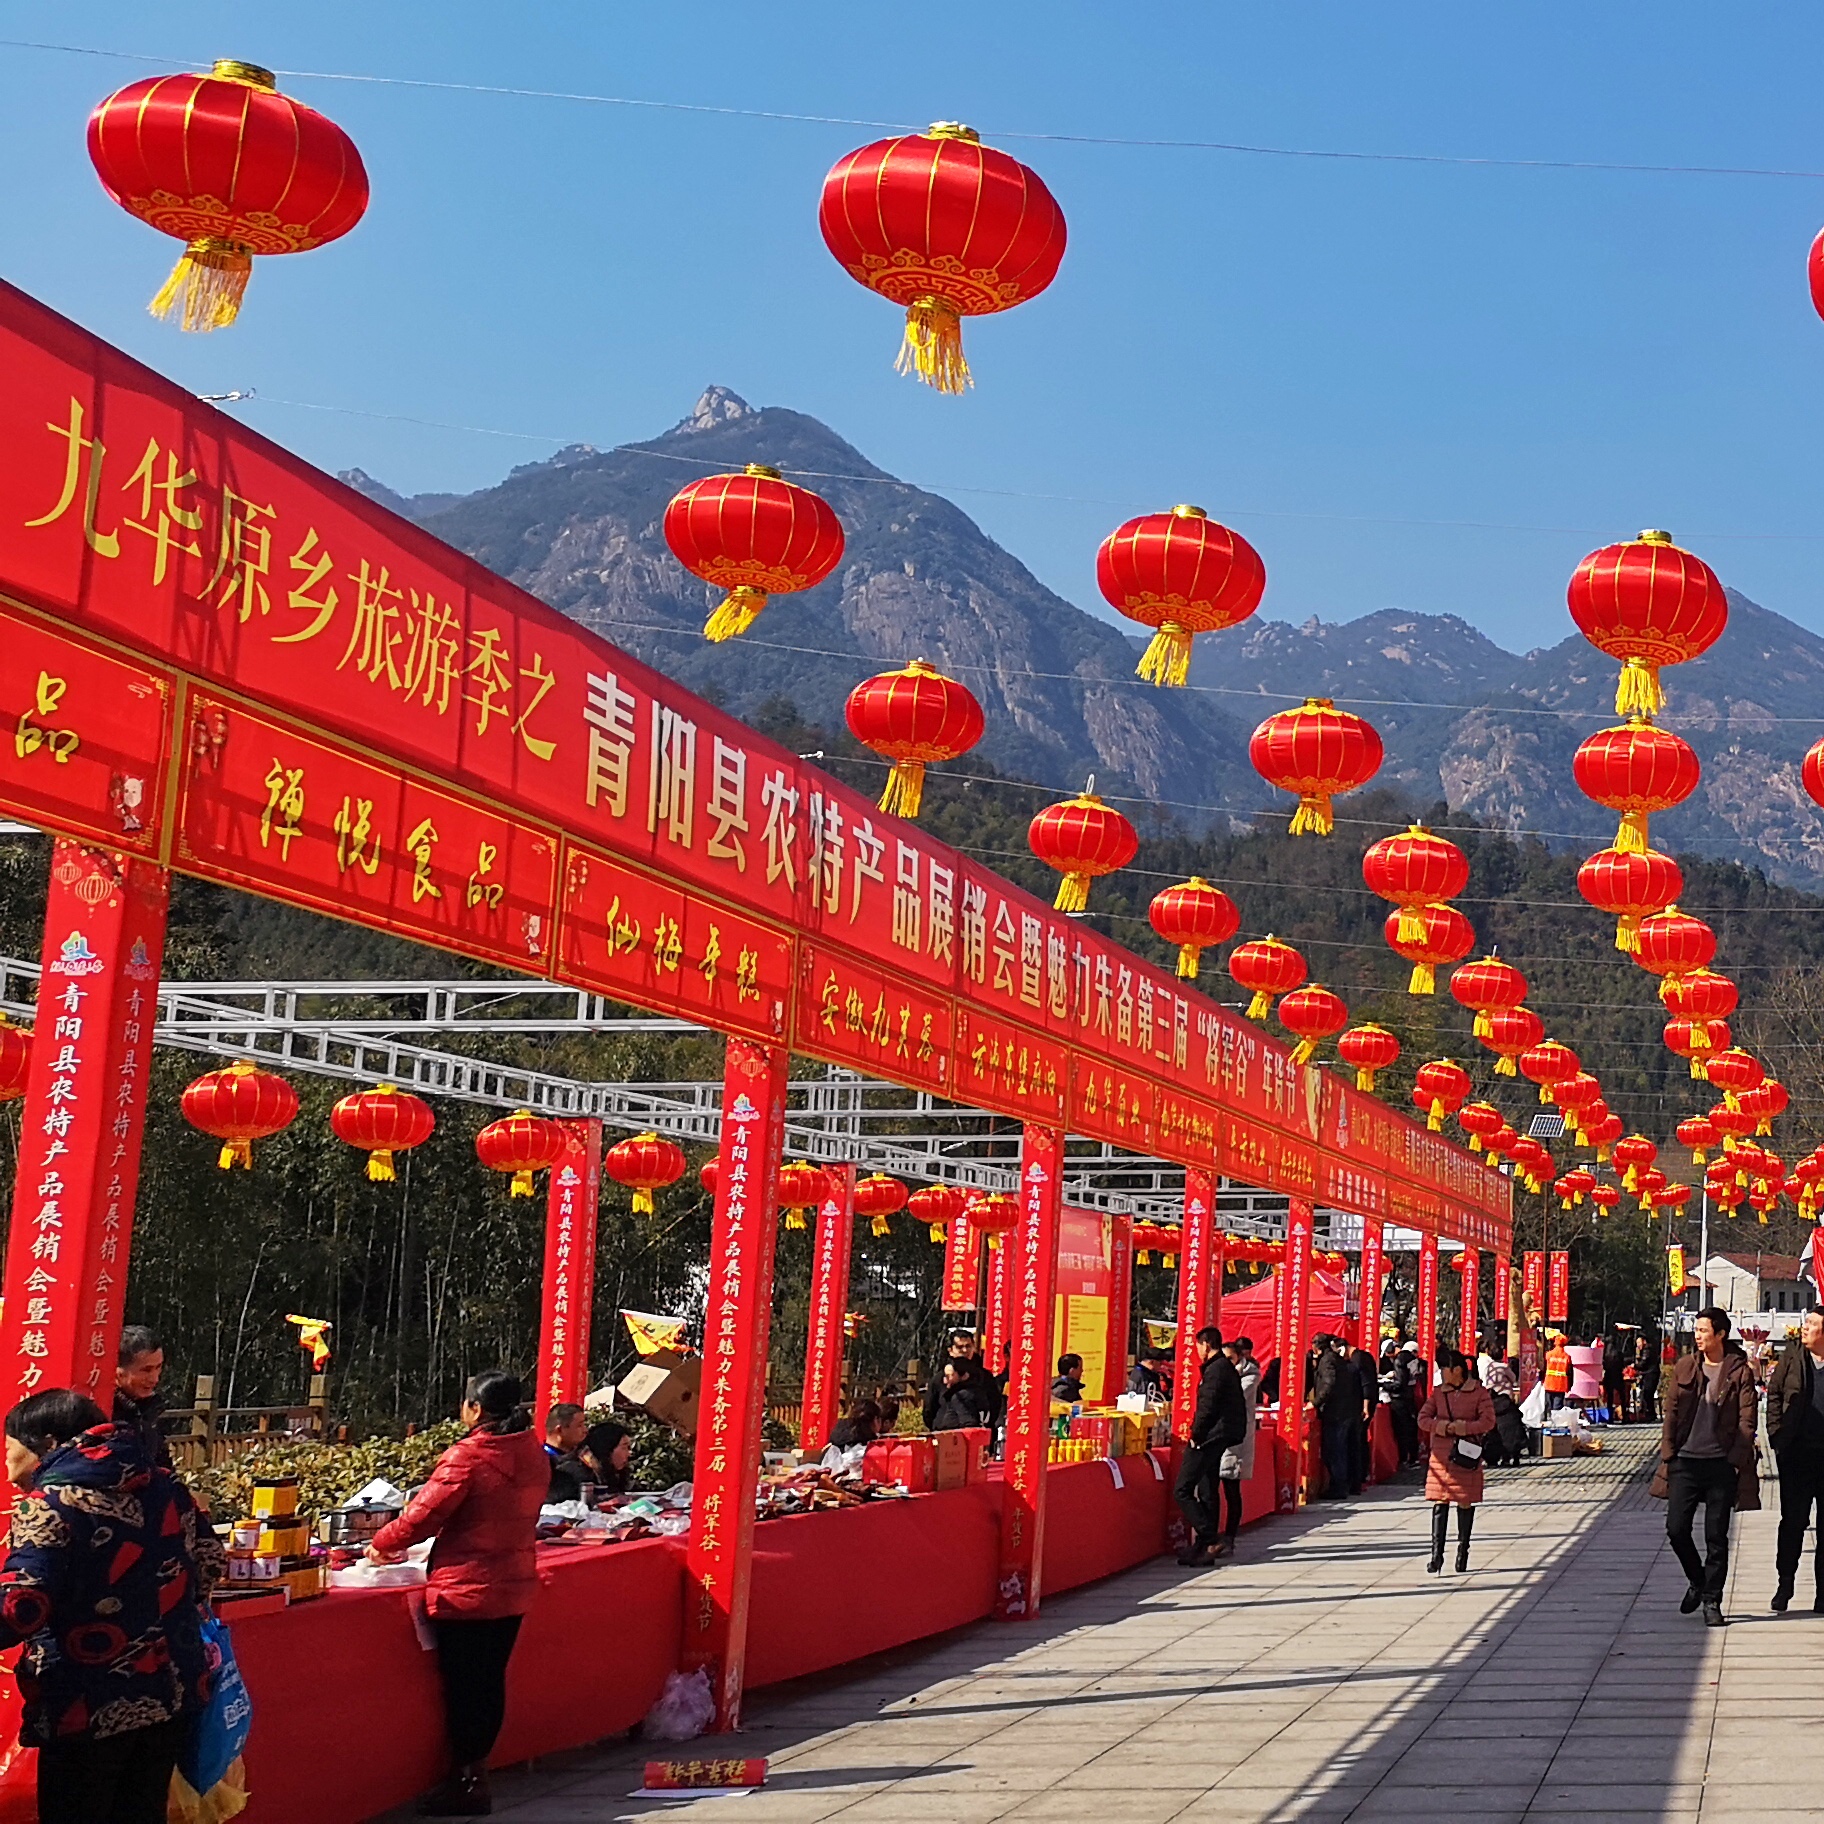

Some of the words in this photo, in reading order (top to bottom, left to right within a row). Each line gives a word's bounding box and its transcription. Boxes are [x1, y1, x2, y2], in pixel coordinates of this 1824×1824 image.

[16, 670, 79, 764] 品
[25, 397, 557, 762] 九华原乡旅游季之
[582, 670, 1188, 1071] 青阳县农特产品展销会暨魅力朱备第三届
[261, 757, 504, 910] 禅悦食品
[606, 896, 761, 1004] 仙梅年糕
[16, 982, 89, 1403] 青阳县农特产品展销会暨魅力
[86, 987, 145, 1404] 青阳县农特产品展销会暨魅力
